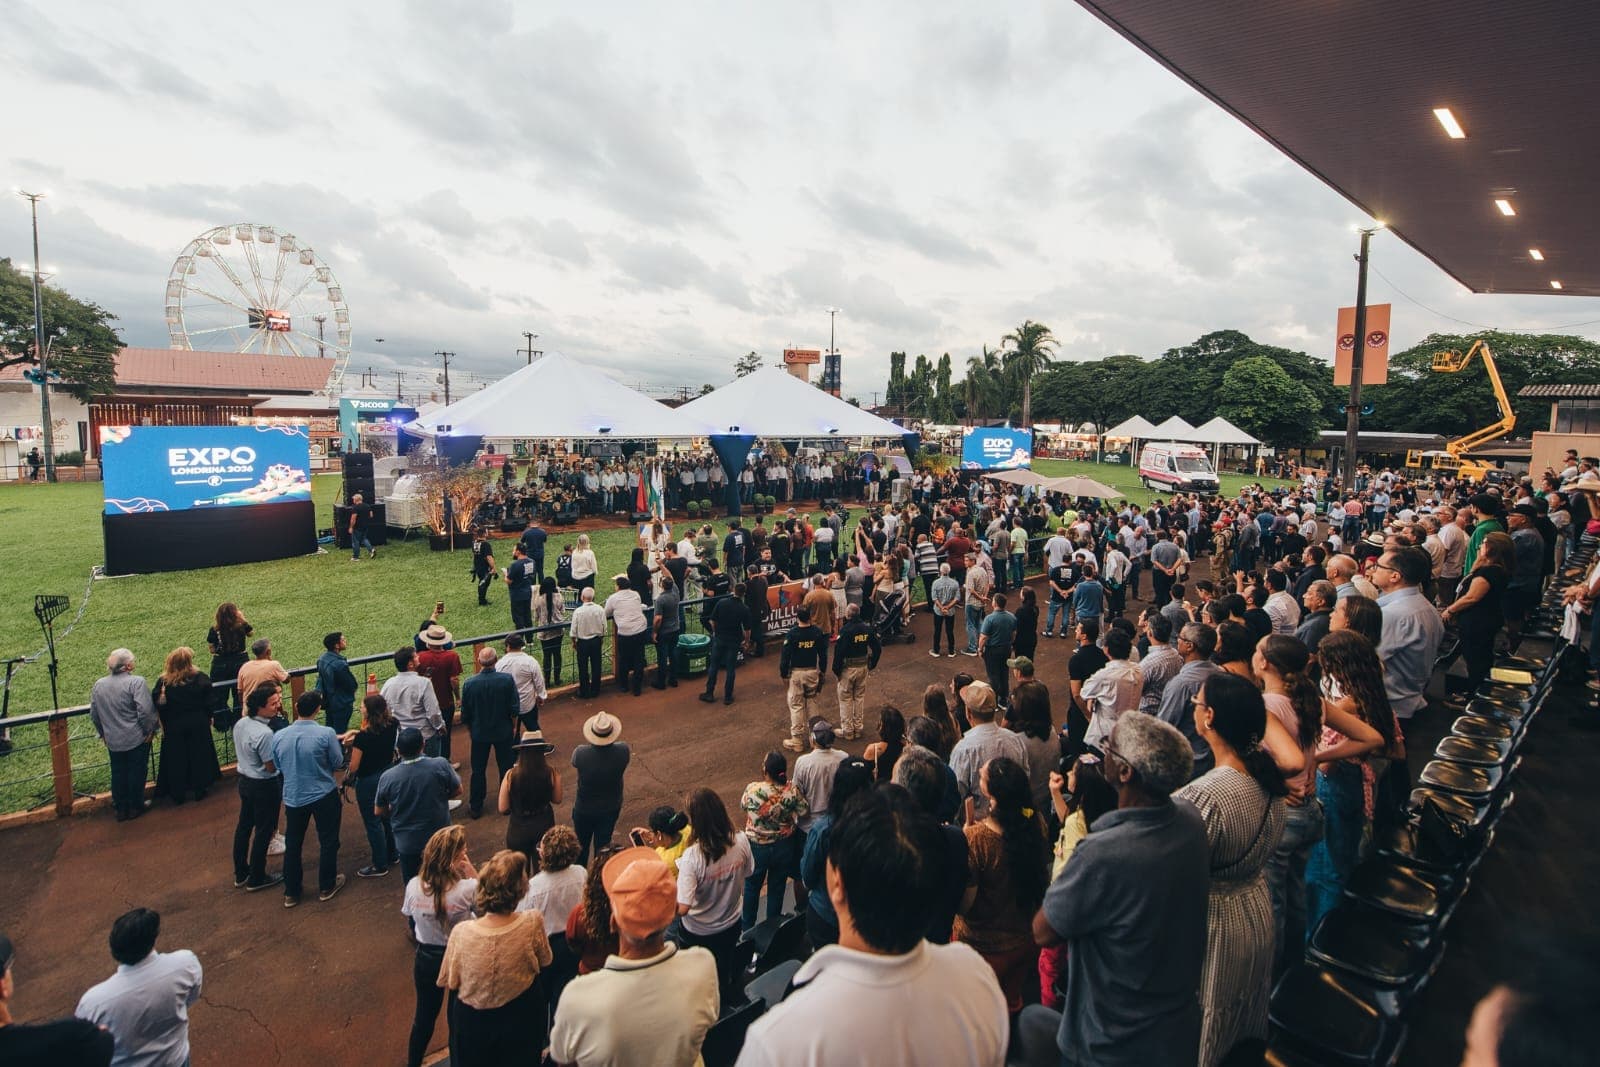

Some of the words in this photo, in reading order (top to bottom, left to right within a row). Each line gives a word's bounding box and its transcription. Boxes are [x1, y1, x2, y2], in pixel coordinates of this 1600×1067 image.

[983, 438, 1013, 448] EXPO
[168, 446, 257, 467] EXPO
[171, 466, 226, 476] LONDRINA
[767, 621, 781, 631] NA
[781, 616, 800, 628] EXP
[798, 640, 815, 649] PRF
